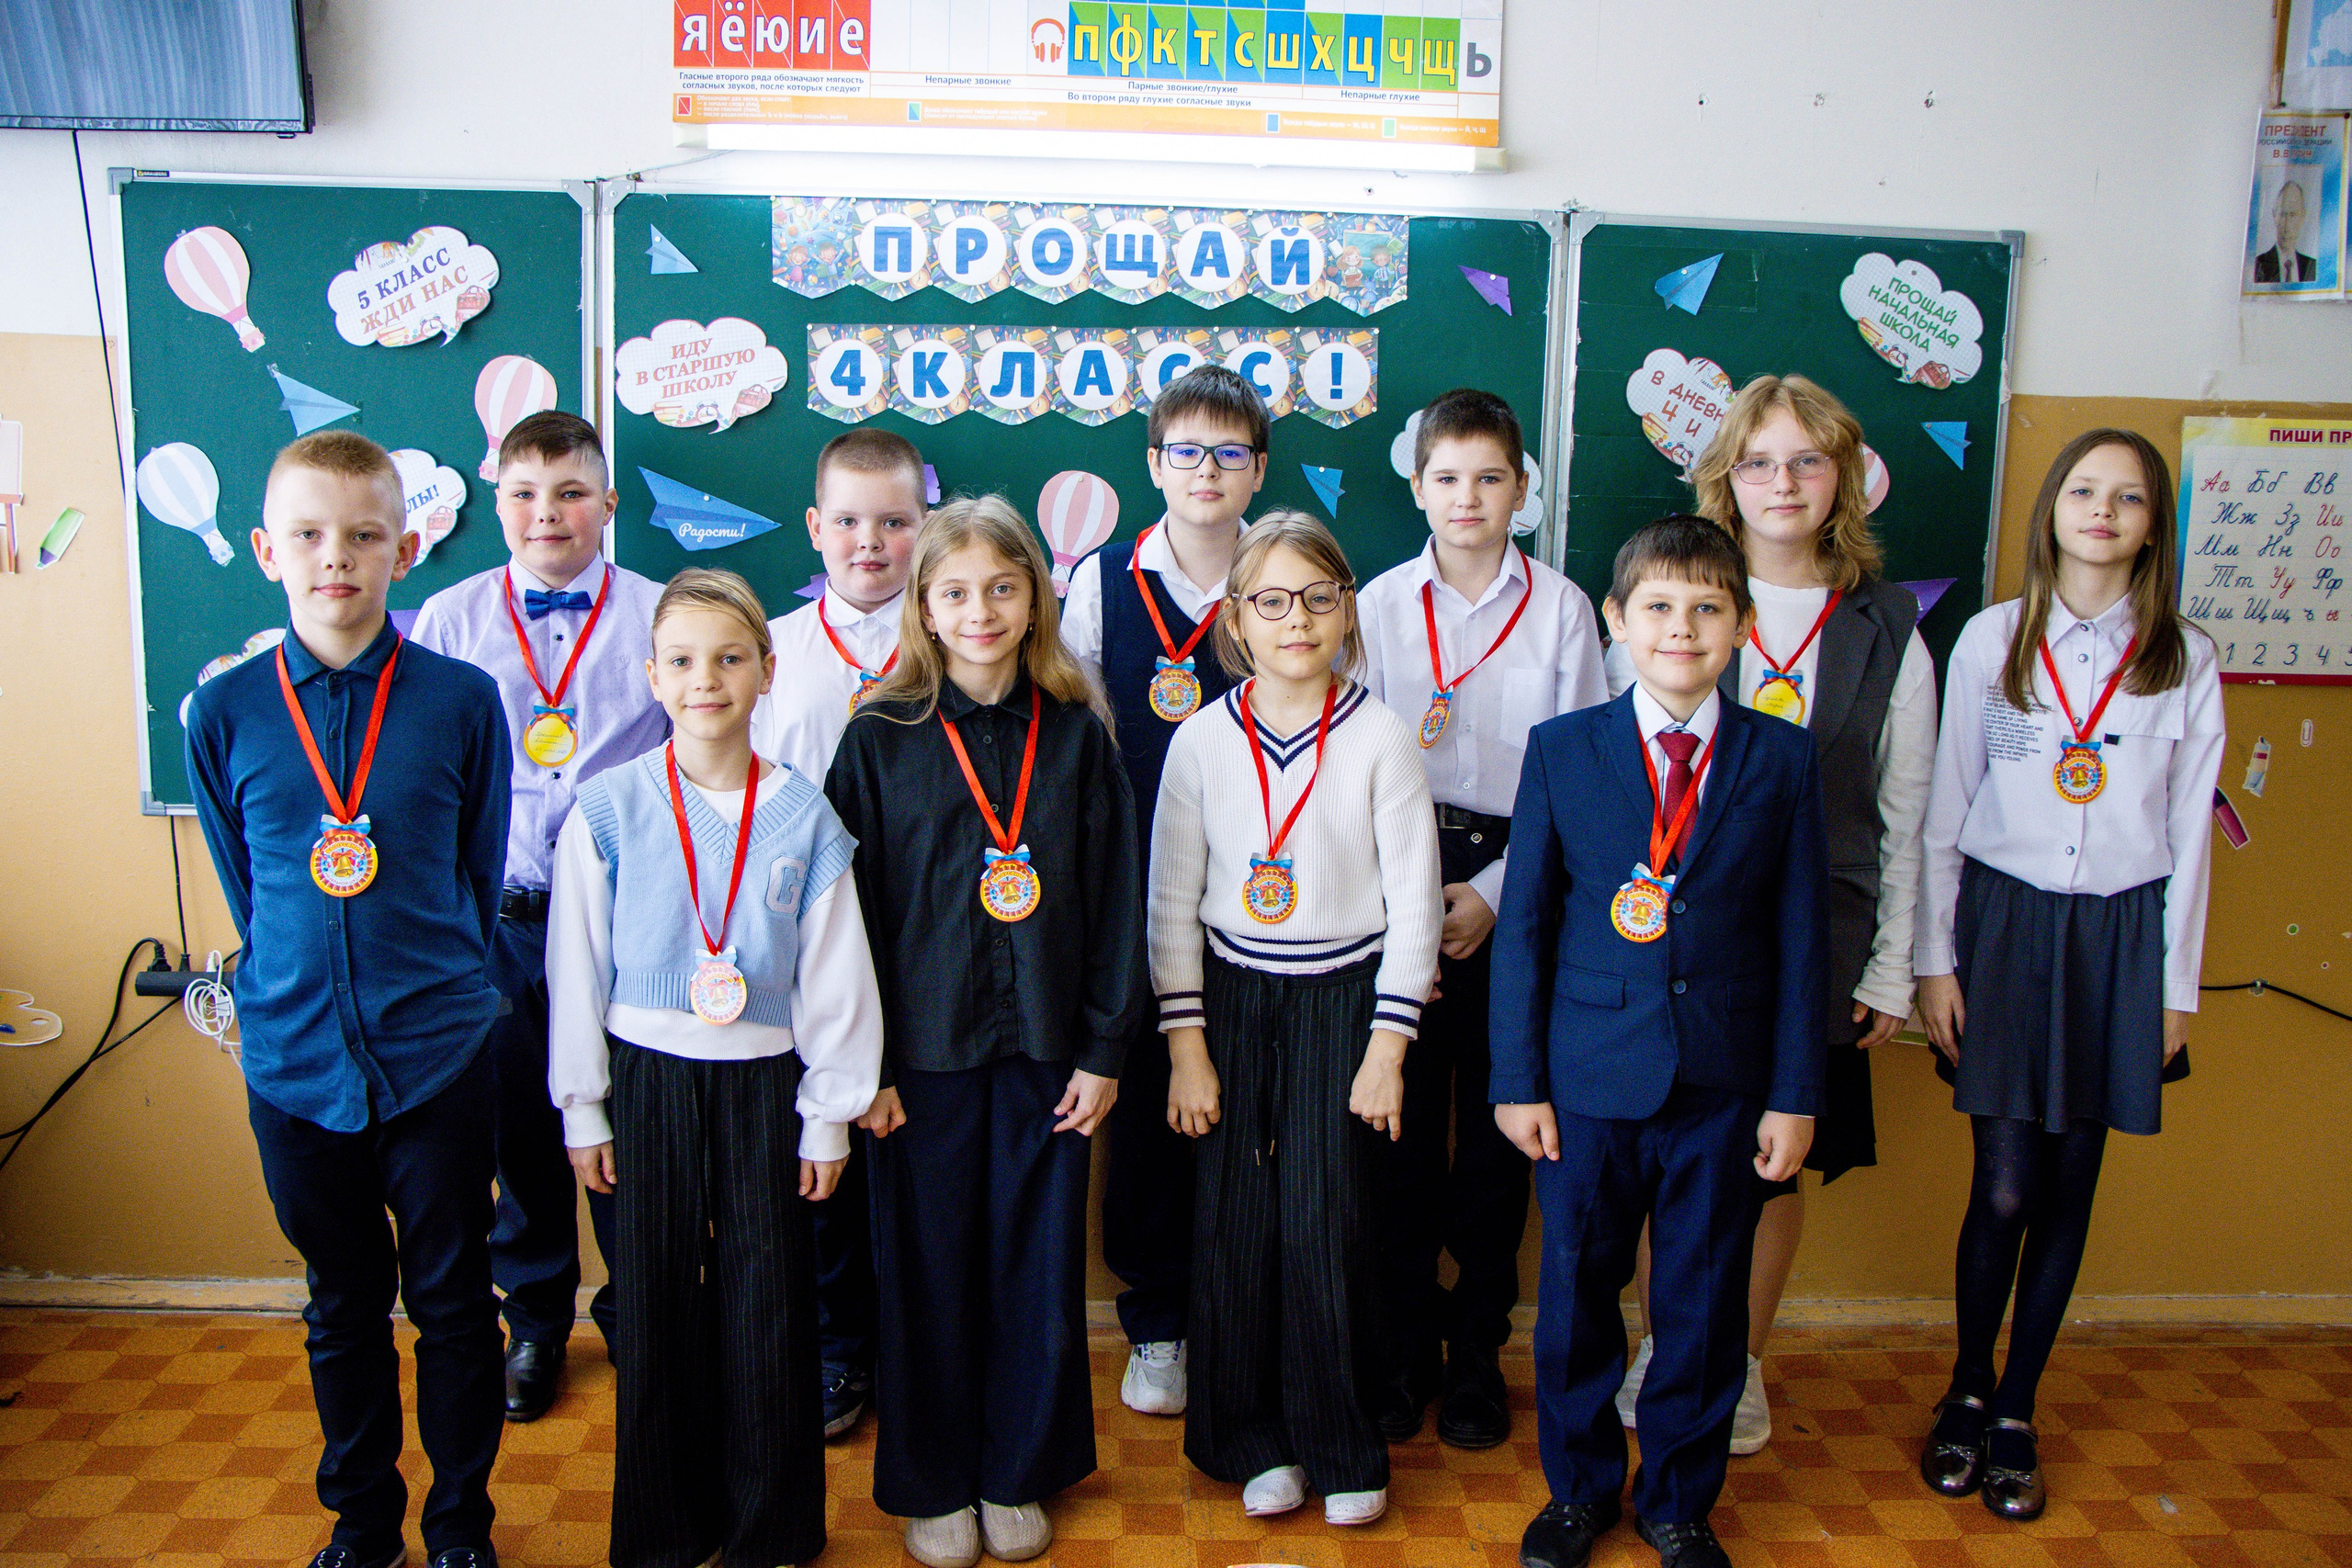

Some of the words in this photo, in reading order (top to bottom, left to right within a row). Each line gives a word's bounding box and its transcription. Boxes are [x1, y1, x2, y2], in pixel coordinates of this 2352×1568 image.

[728, 83, 758, 91] звуков,
[787, 85, 823, 93] которых
[774, 74, 824, 83] обозначают
[826, 76, 864, 85] мягкость
[925, 75, 972, 86] Непарные
[1128, 81, 1164, 91] Парные
[1166, 85, 1238, 94] звонкие/глухие
[1068, 92, 1079, 101] Во
[1118, 96, 1140, 104] ряду
[1226, 100, 1251, 108] звуки
[1340, 90, 1386, 100] Непарные
[1389, 93, 1420, 102] глухие
[874, 226, 1310, 286] ПРОЩАЙ
[357, 290, 370, 310] 5
[375, 248, 451, 300] КЛАСС
[360, 293, 416, 334] ЖДИ
[420, 265, 468, 303] НАС
[1888, 277, 1957, 326] ПРОЩАЙ
[1868, 285, 1960, 349] НАЧАЛЬНАЯ
[1879, 311, 1930, 352] ШКОЛА
[671, 338, 713, 360] ИДУ
[636, 371, 648, 386] В
[653, 348, 755, 382] СТАРШУЮ
[831, 349, 866, 396] 4
[1651, 370, 1665, 386] В
[662, 370, 738, 399] ШКОЛУ
[1685, 418, 1702, 437] И
[2269, 429, 2323, 443] ПИШИ
[2200, 470, 2231, 492] Аа
[2247, 469, 2288, 493] Бб
[2304, 471, 2338, 494] Вв
[2211, 502, 2258, 525] Жж
[2275, 503, 2301, 536] Зз
[2316, 504, 2343, 527] Ии
[678, 523, 746, 543] Радости!
[2194, 534, 2239, 557] Мм
[2257, 534, 2293, 558] Нн
[2205, 564, 2254, 588] Тт
[2312, 567, 2343, 600] Фф
[2187, 596, 2233, 620] Шш
[2326, 609, 2340, 621] ы
[2225, 643, 2236, 665] 1
[2252, 643, 2267, 666] 2
[2283, 644, 2298, 666] 3
[2317, 644, 2330, 666] 4
